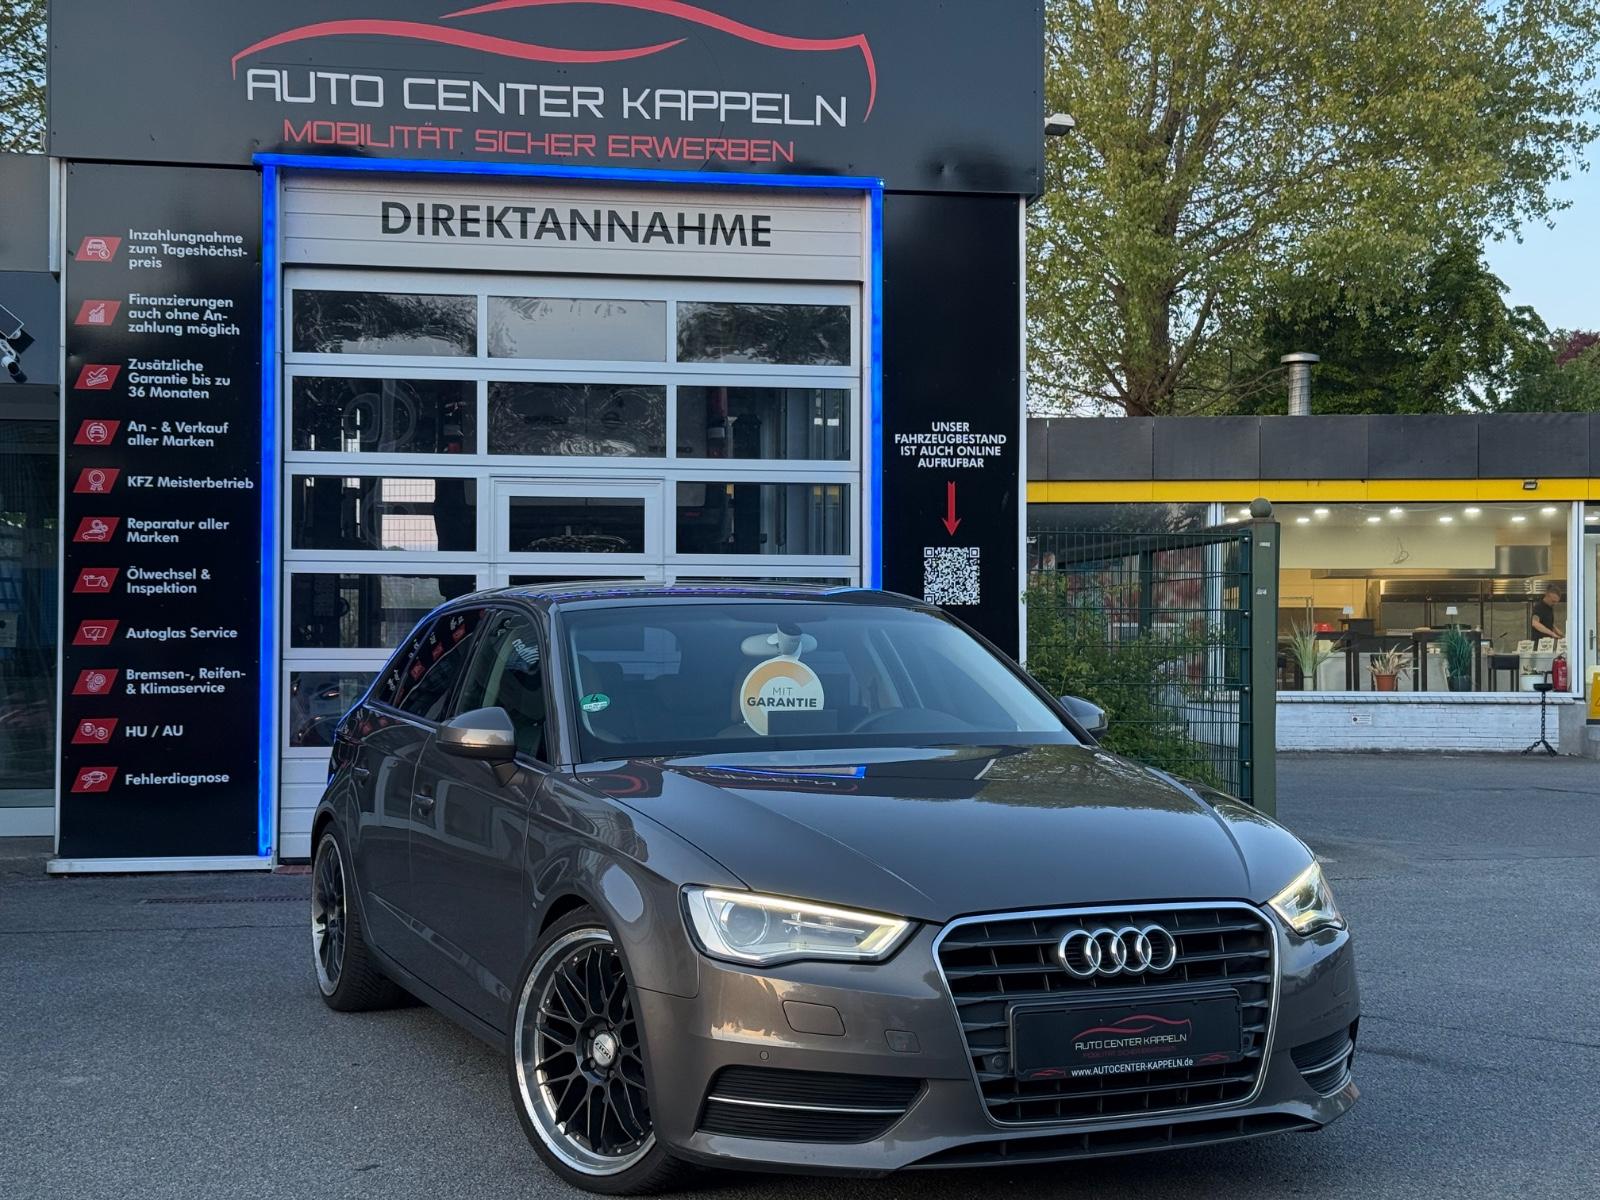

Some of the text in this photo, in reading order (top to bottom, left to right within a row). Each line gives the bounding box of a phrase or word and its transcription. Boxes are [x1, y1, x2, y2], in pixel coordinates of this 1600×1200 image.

[247, 68, 846, 127] AUTO CENTER KAPPELN
[284, 119, 794, 163] MOBILITÄT SICHER ERWERBEN
[382, 201, 771, 248] DIREKTANNAHME
[129, 229, 243, 246] Inzahlungnahme
[129, 244, 248, 260] zum Tageshöchst-
[129, 258, 162, 270] preis
[129, 294, 233, 310] Finanzierungen
[129, 308, 227, 321] auch ohne An-
[128, 323, 240, 337] zahlung möglich
[128, 359, 203, 371] Zusätzliche
[129, 373, 230, 386] Garantie bis zu
[128, 387, 209, 399] 36 Monaten
[161, 422, 171, 433] &
[175, 422, 229, 434] Verkauf
[932, 422, 969, 431] UNSER
[128, 435, 214, 447] aller Marken
[895, 434, 1006, 444] FAHRZEUGBESTAND
[901, 446, 1001, 456] IST AUCH ONLINE
[918, 458, 984, 467] AUFRUFBAR
[128, 476, 253, 489] KFZ Meisterbetrieb
[128, 518, 229, 531] Reparatur aller
[127, 532, 179, 543] Marken
[127, 566, 211, 580] Ölwechsel &
[127, 582, 197, 596] Inspektion
[126, 627, 238, 641] Autoglas Service
[127, 668, 246, 681] Bremsen-, Reifen-
[127, 683, 225, 694] & Klimaservice
[773, 687, 792, 695] MIT
[747, 697, 817, 707] GARANTIE
[126, 726, 147, 736] HU
[162, 725, 183, 736] AU
[126, 773, 229, 785] Fehlerdiagnose
[1076, 1034, 1187, 1050] AUTO CENTER KAPPELN
[1072, 1058, 1193, 1077] www.AUTOCENTER-KAPPELN.de
